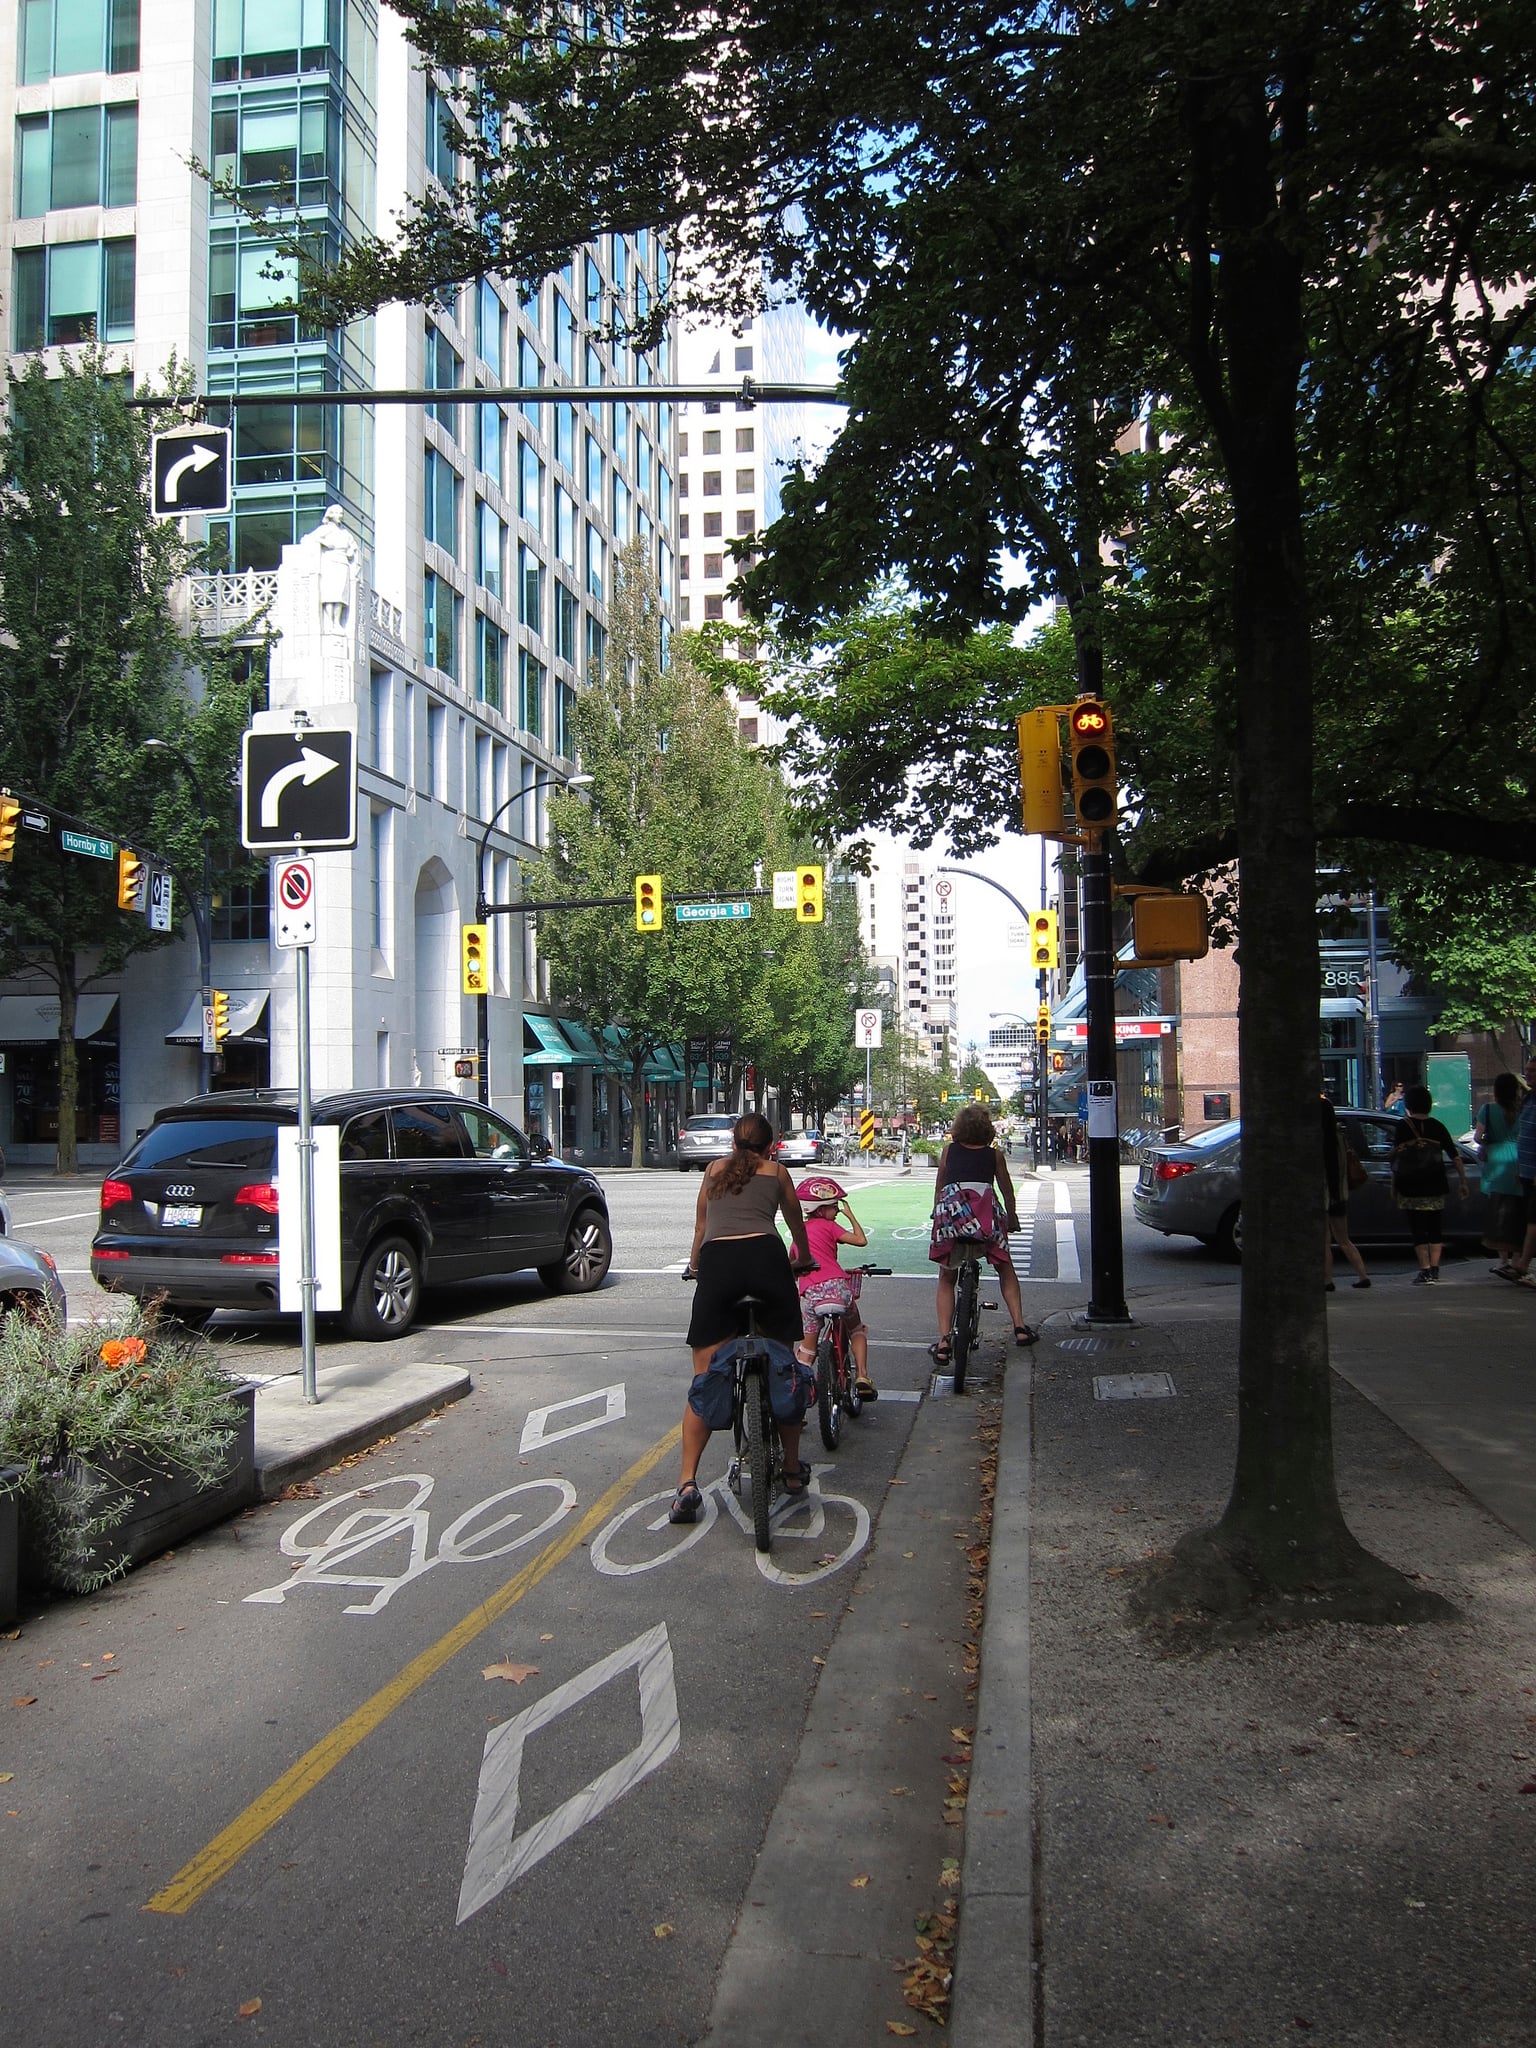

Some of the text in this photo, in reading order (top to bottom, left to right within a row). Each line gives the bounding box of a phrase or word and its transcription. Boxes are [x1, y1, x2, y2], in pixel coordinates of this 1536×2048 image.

[66, 834, 109, 855] Hornby St
[682, 905, 745, 919] Georgia St
[1324, 971, 1360, 986] 885
[1115, 1025, 1141, 1034] KING
